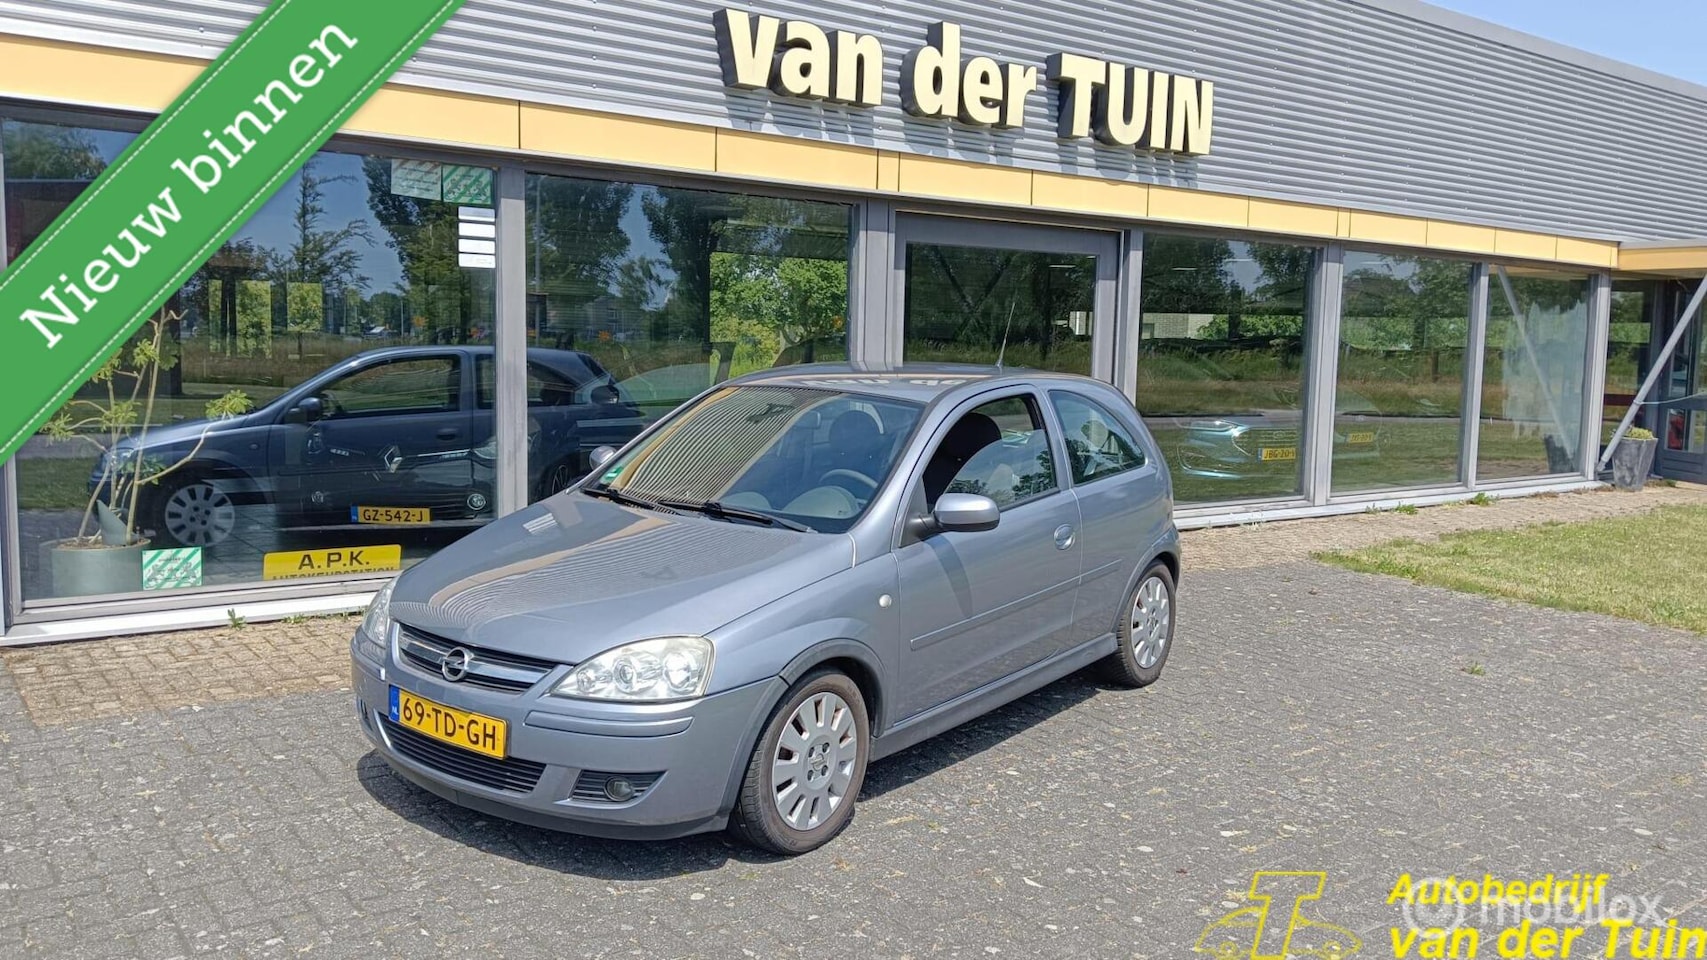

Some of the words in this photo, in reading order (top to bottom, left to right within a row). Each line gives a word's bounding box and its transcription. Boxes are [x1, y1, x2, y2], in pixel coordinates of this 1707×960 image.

[714, 8, 883, 106] van
[901, 21, 1037, 128] der
[1047, 51, 1213, 157] TUIN
[363, 509, 423, 523] GZ-542-J
[297, 550, 370, 570] A.P.K.
[403, 698, 496, 751] 69-TD-GH
